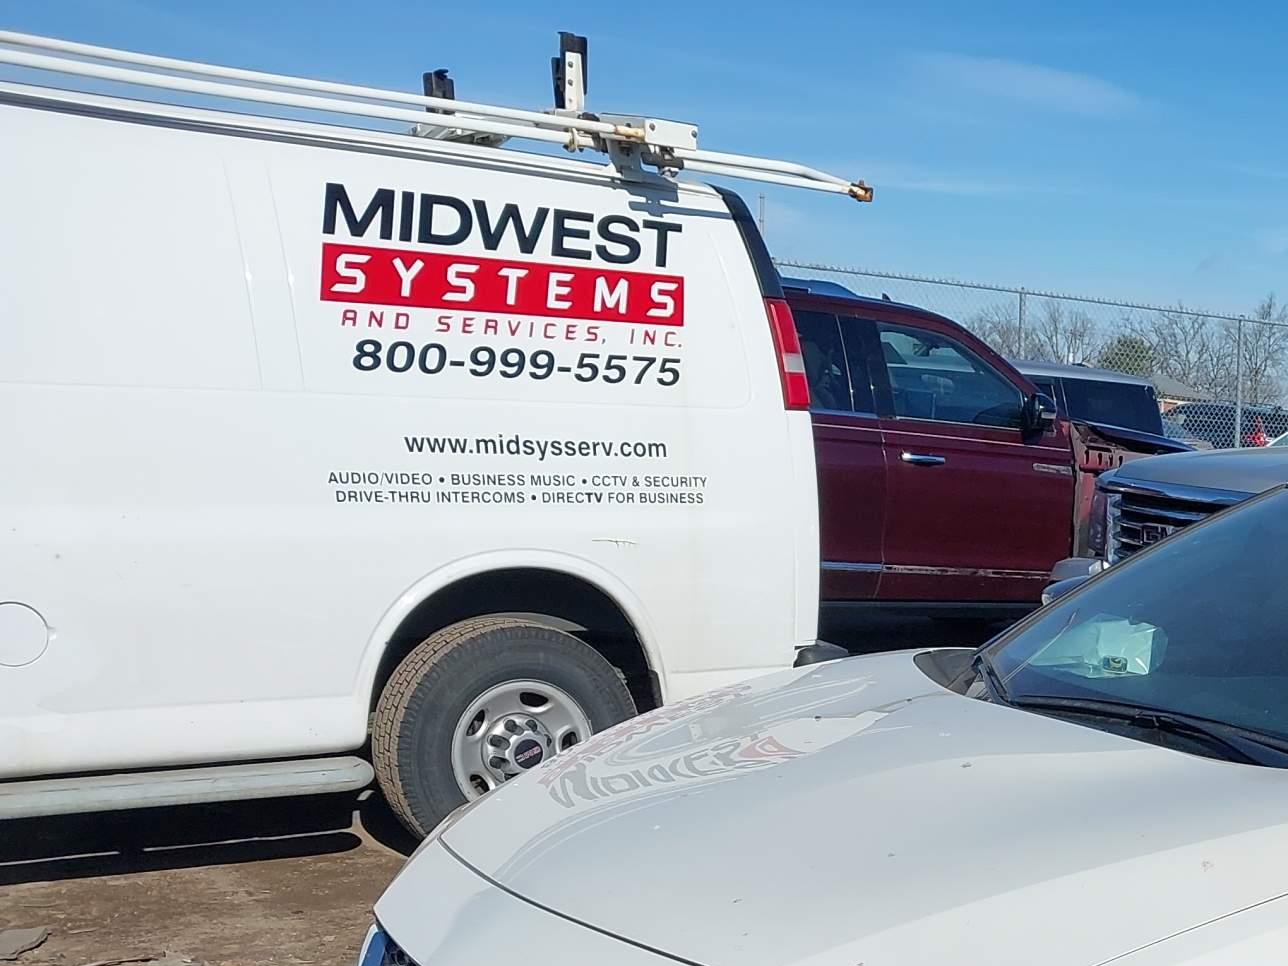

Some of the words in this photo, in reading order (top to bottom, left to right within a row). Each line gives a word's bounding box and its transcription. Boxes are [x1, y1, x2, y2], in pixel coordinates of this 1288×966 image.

[322, 182, 682, 268] MIDWEST
[330, 253, 680, 318] SYSTEMS
[341, 309, 410, 330] AND
[630, 328, 682, 348] INC.
[352, 338, 681, 387] 800-999-5575
[404, 433, 668, 461] www.midsysserv.com
[328, 471, 433, 486] AUDIO/VIDEO
[451, 473, 526, 487] BUSINESS
[530, 474, 576, 488] MUSIC
[591, 475, 628, 488] CCTV
[632, 475, 640, 488] &
[643, 475, 708, 489] SECURITY
[335, 490, 431, 503] DRIVE-THRU
[437, 491, 526, 504] INTERCOMS
[542, 491, 603, 504] DIRECTV
[608, 492, 635, 504] FOR
[639, 492, 704, 505] BUSINESS
